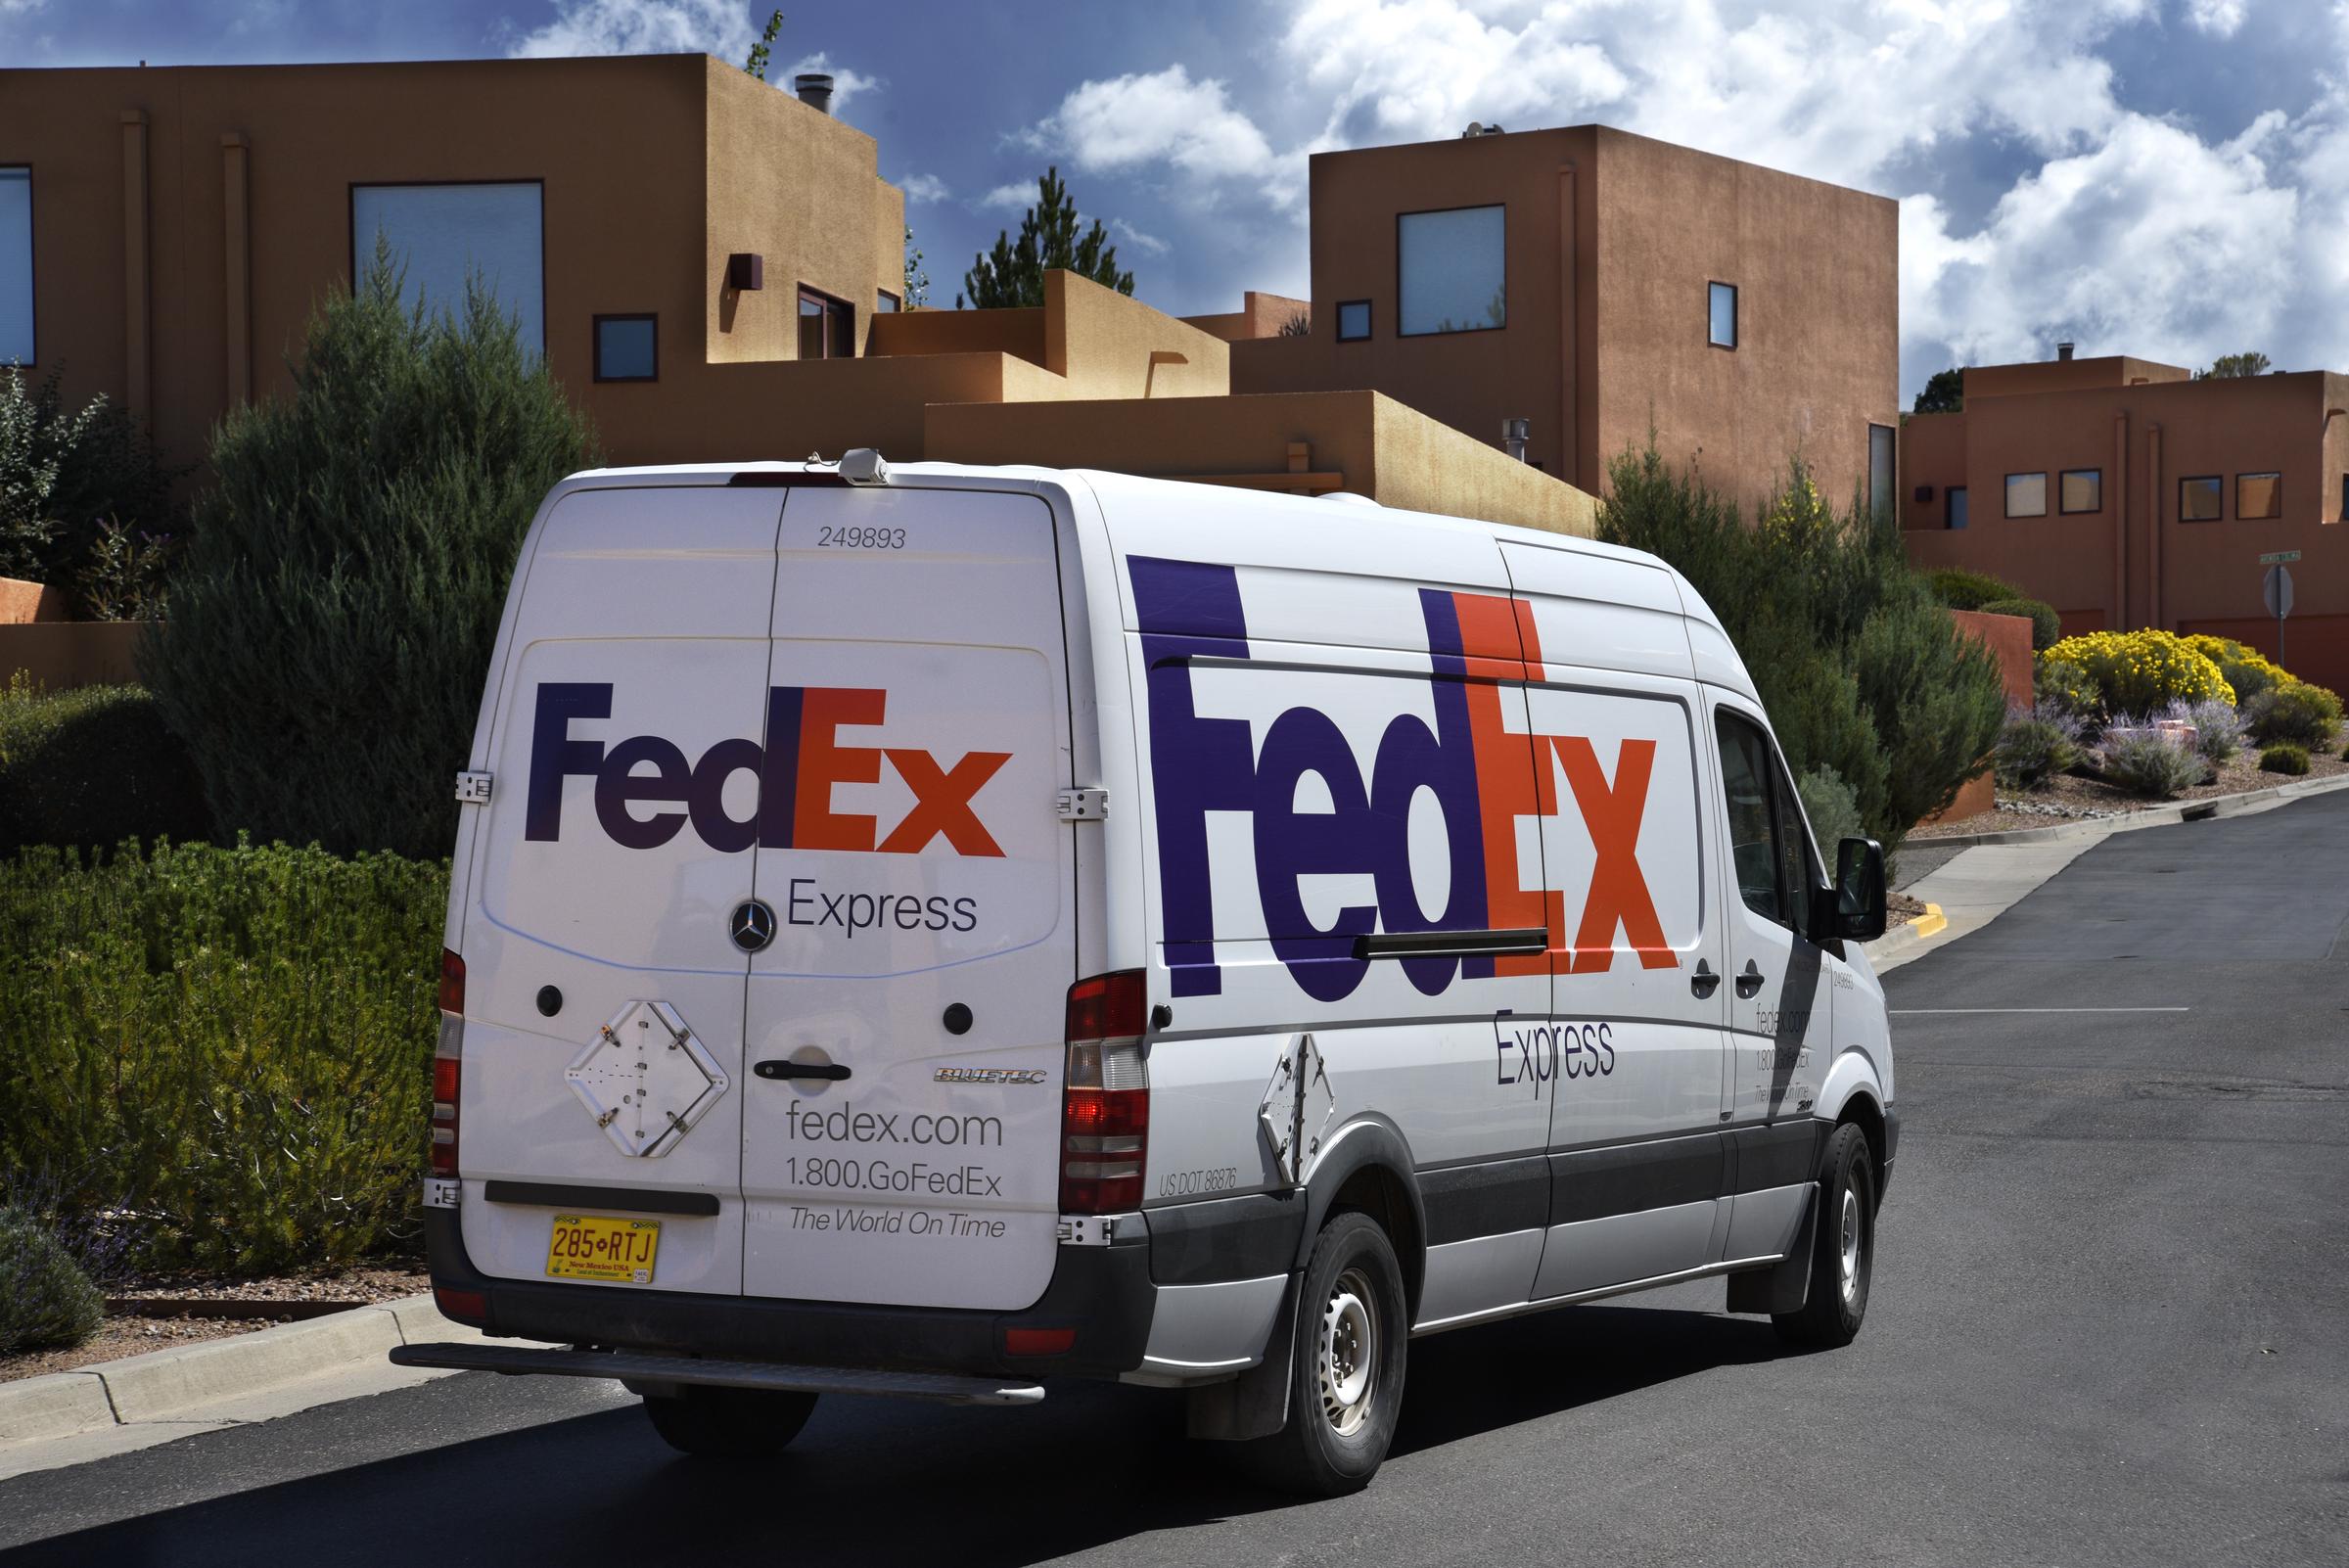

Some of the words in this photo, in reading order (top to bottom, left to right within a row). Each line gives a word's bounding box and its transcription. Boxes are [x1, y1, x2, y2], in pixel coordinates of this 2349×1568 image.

[817, 526, 906, 549] 249893
[525, 682, 1014, 857] FedEx
[1127, 554, 1680, 1002] FedEx
[787, 878, 979, 940] Express
[933, 1067, 1047, 1084] BLUETEC
[1494, 1009, 1615, 1101] Express
[786, 1099, 1003, 1146] fedex.com
[786, 1157, 1002, 1197] 1.800.GoFedEx
[1159, 1174, 1176, 1197] US
[1178, 1171, 1205, 1195] DOT
[1204, 1168, 1237, 1191] 86876
[790, 1206, 831, 1231] The
[836, 1208, 903, 1234] World
[908, 1211, 944, 1236] On
[947, 1213, 1007, 1238] Time
